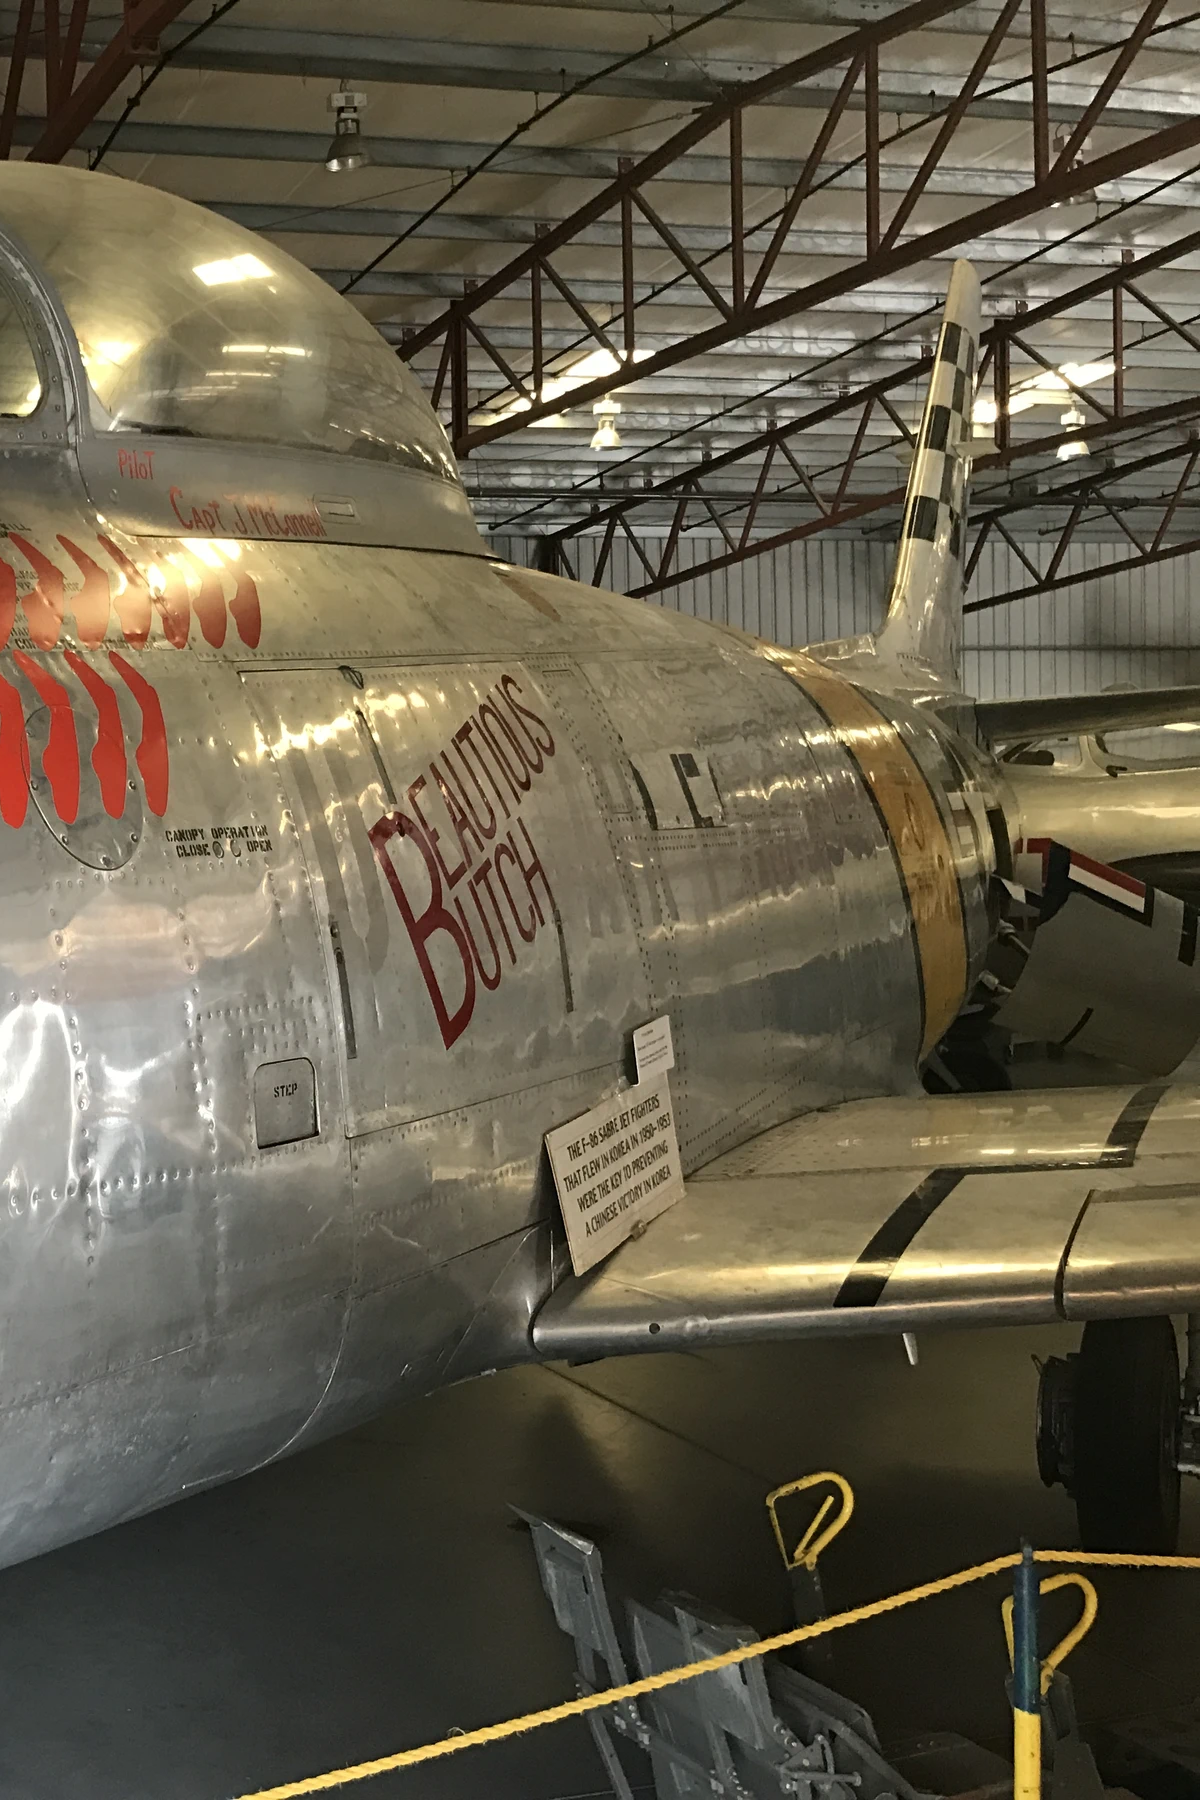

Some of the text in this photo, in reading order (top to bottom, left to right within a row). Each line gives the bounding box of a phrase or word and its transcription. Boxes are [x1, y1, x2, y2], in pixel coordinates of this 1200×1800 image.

[165, 828, 205, 842] CANOPY
[175, 839, 273, 858] CLOSE OPEN
[273, 1082, 298, 1098] STEP
[563, 1112, 671, 1193] THAT FLEW IN KOREA IN 1950-1953
[566, 1093, 661, 1162] THE F-86 SABRE JET FIGHTERS
[576, 1139, 669, 1213] WERE THE KEY TO PREVENTING
[585, 1164, 672, 1238] A CHINESE VICTORY IN KOREA
